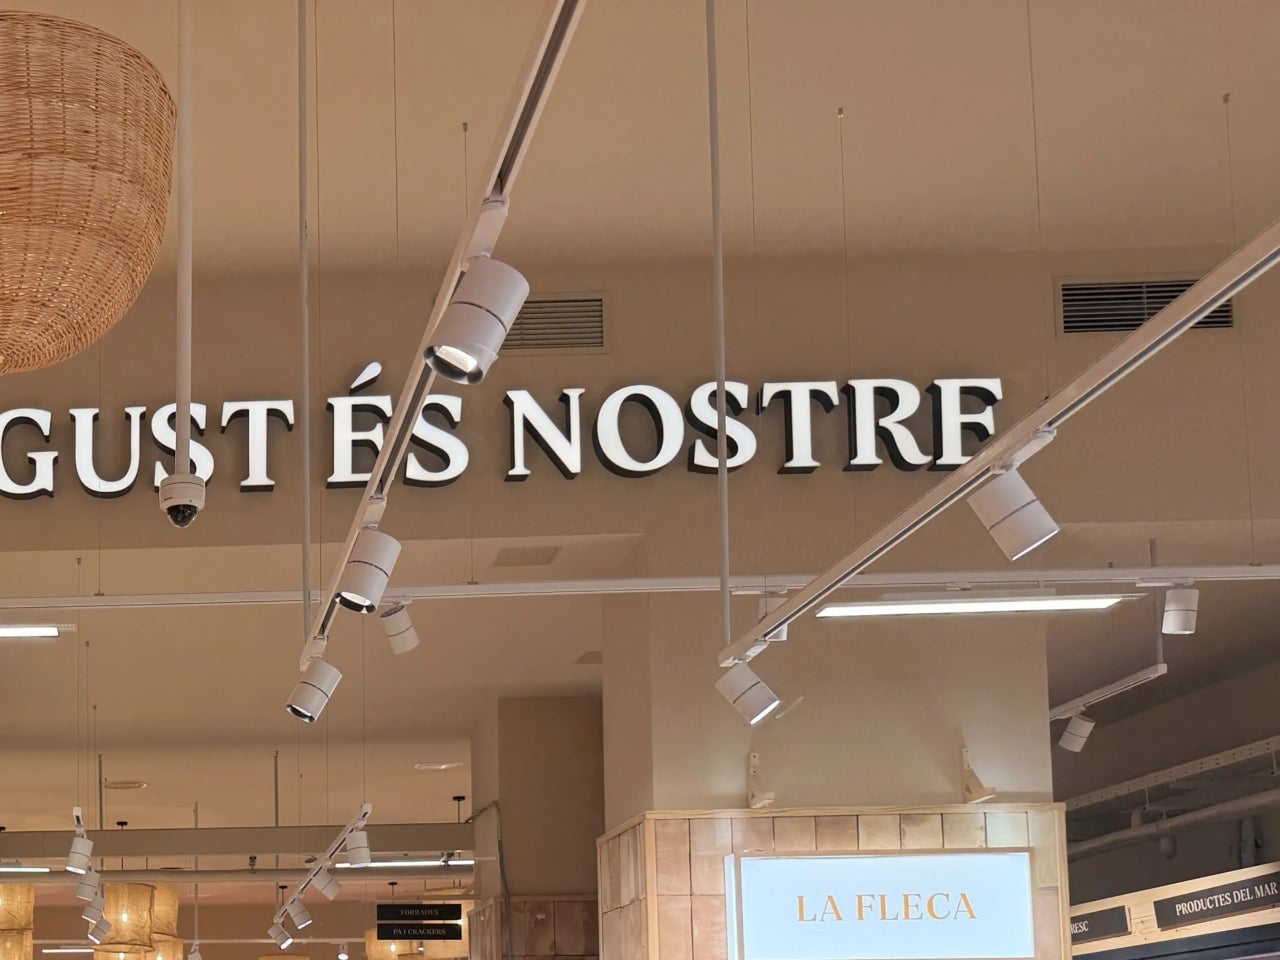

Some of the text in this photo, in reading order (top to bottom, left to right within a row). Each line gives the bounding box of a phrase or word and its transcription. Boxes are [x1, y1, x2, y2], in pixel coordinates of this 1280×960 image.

[327, 362, 470, 484] ÉS
[505, 377, 1004, 476] NOSTRE
[796, 893, 977, 922] LA FLECA
[1175, 881, 1279, 916] PRODUCTES DEL MAR
[1070, 919, 1090, 935] RESC
